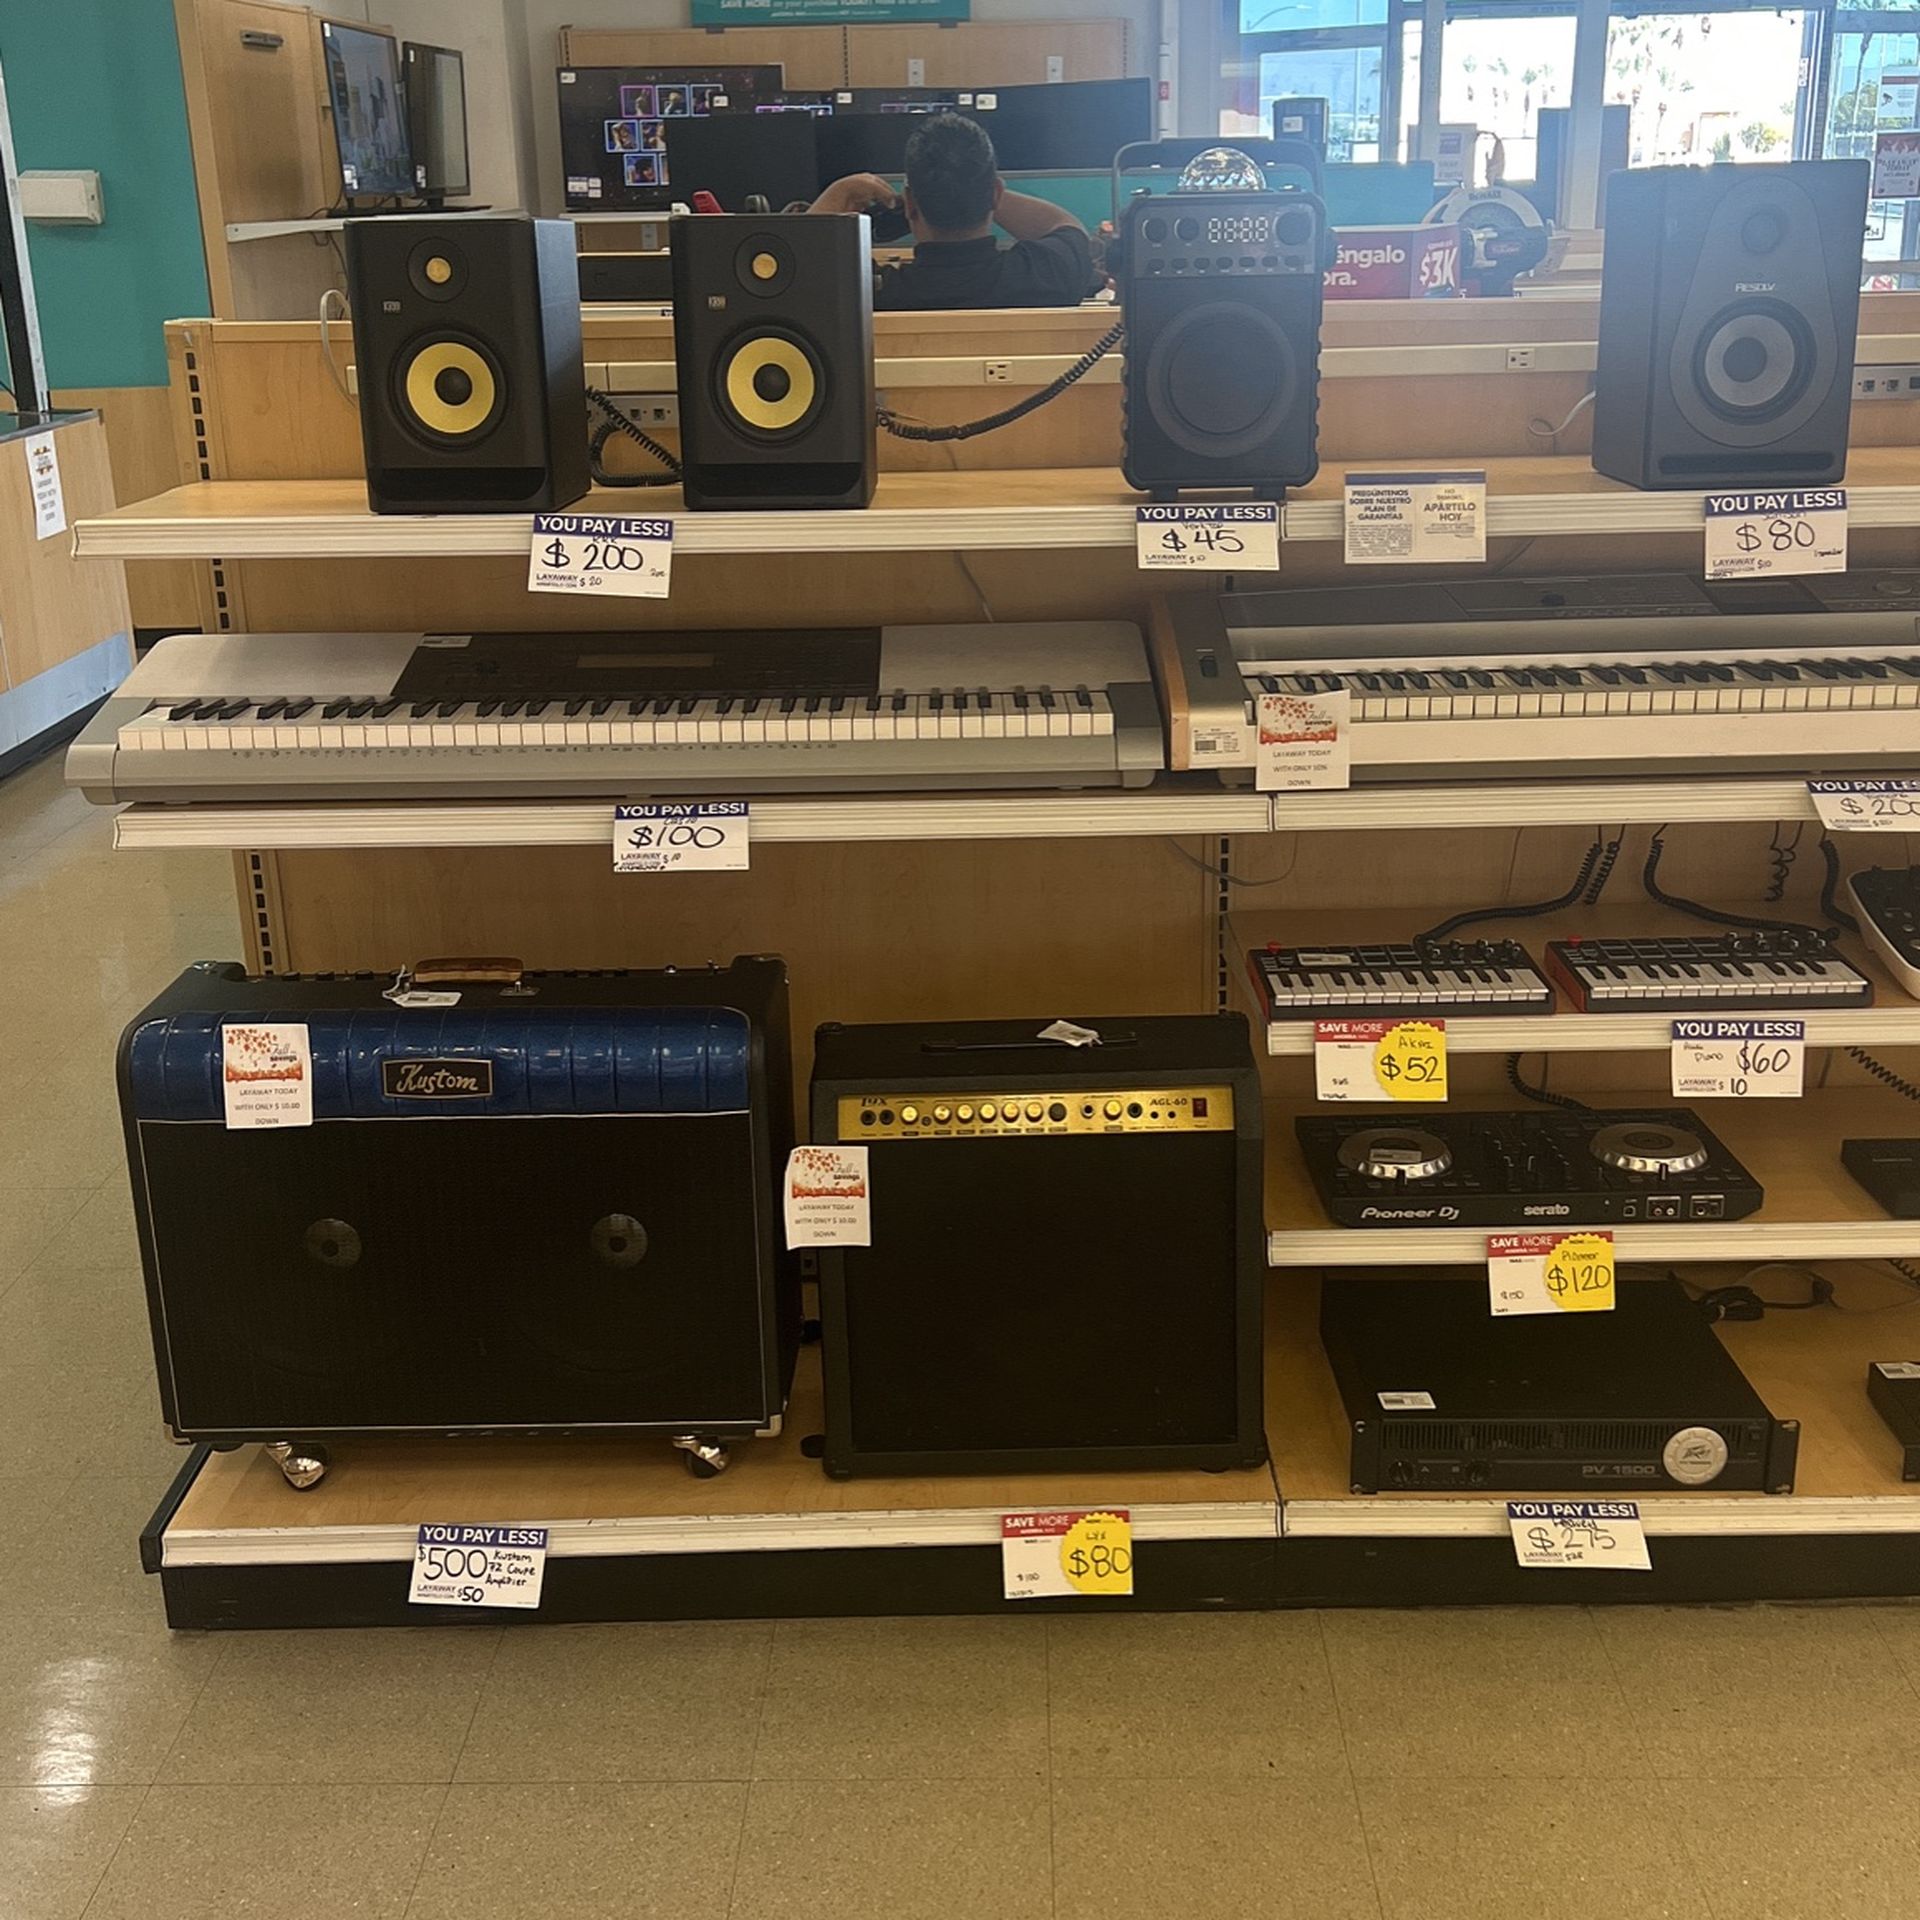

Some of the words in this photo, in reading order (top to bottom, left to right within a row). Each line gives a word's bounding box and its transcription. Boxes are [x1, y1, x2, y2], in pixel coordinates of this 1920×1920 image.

[1419, 246, 1459, 289] $3K
[1709, 496, 1749, 513] YOU
[1754, 493, 1788, 510] PAY
[1793, 491, 1843, 508] LESS!
[1140, 508, 1179, 519] YOU
[1184, 508, 1218, 519] PAY
[1223, 507, 1272, 520] LESS!
[1439, 512, 1463, 521] HOY
[538, 516, 576, 532] YOU
[582, 518, 616, 534] PAY
[620, 520, 669, 537] LESS!
[1713, 558, 1755, 567] LAYAWAY
[1810, 781, 1850, 792] YOU
[1854, 782, 1887, 791] PAY
[620, 806, 656, 817] YOU
[661, 804, 694, 816] PAY
[698, 802, 745, 814] LESS!
[628, 825, 725, 849] $100
[1318, 1023, 1348, 1033] SAVE
[1351, 1022, 1383, 1033] MORE
[1676, 1022, 1713, 1036] YOU
[1717, 1022, 1750, 1036] PAY
[1754, 1022, 1801, 1036] LESS!
[1736, 1040, 1791, 1076] $60
[1380, 1053, 1443, 1082] $52
[396, 1064, 480, 1094] Kustom
[1361, 1206, 1436, 1218] Pioneer
[1524, 1204, 1570, 1216] serato
[1491, 1238, 1519, 1248] SAVE
[1522, 1236, 1553, 1247] MORE
[1547, 1264, 1612, 1297] $120
[1511, 1504, 1548, 1516] YOU
[1552, 1504, 1584, 1516] PAY
[1588, 1504, 1636, 1516] LESS!
[1005, 1517, 1034, 1528] SAVE
[1038, 1516, 1069, 1526] MORE
[424, 1526, 460, 1542] YOU
[463, 1528, 495, 1543] PAY
[498, 1530, 544, 1545] LESS!
[418, 1545, 488, 1580] $500
[1068, 1545, 1132, 1578] $80
